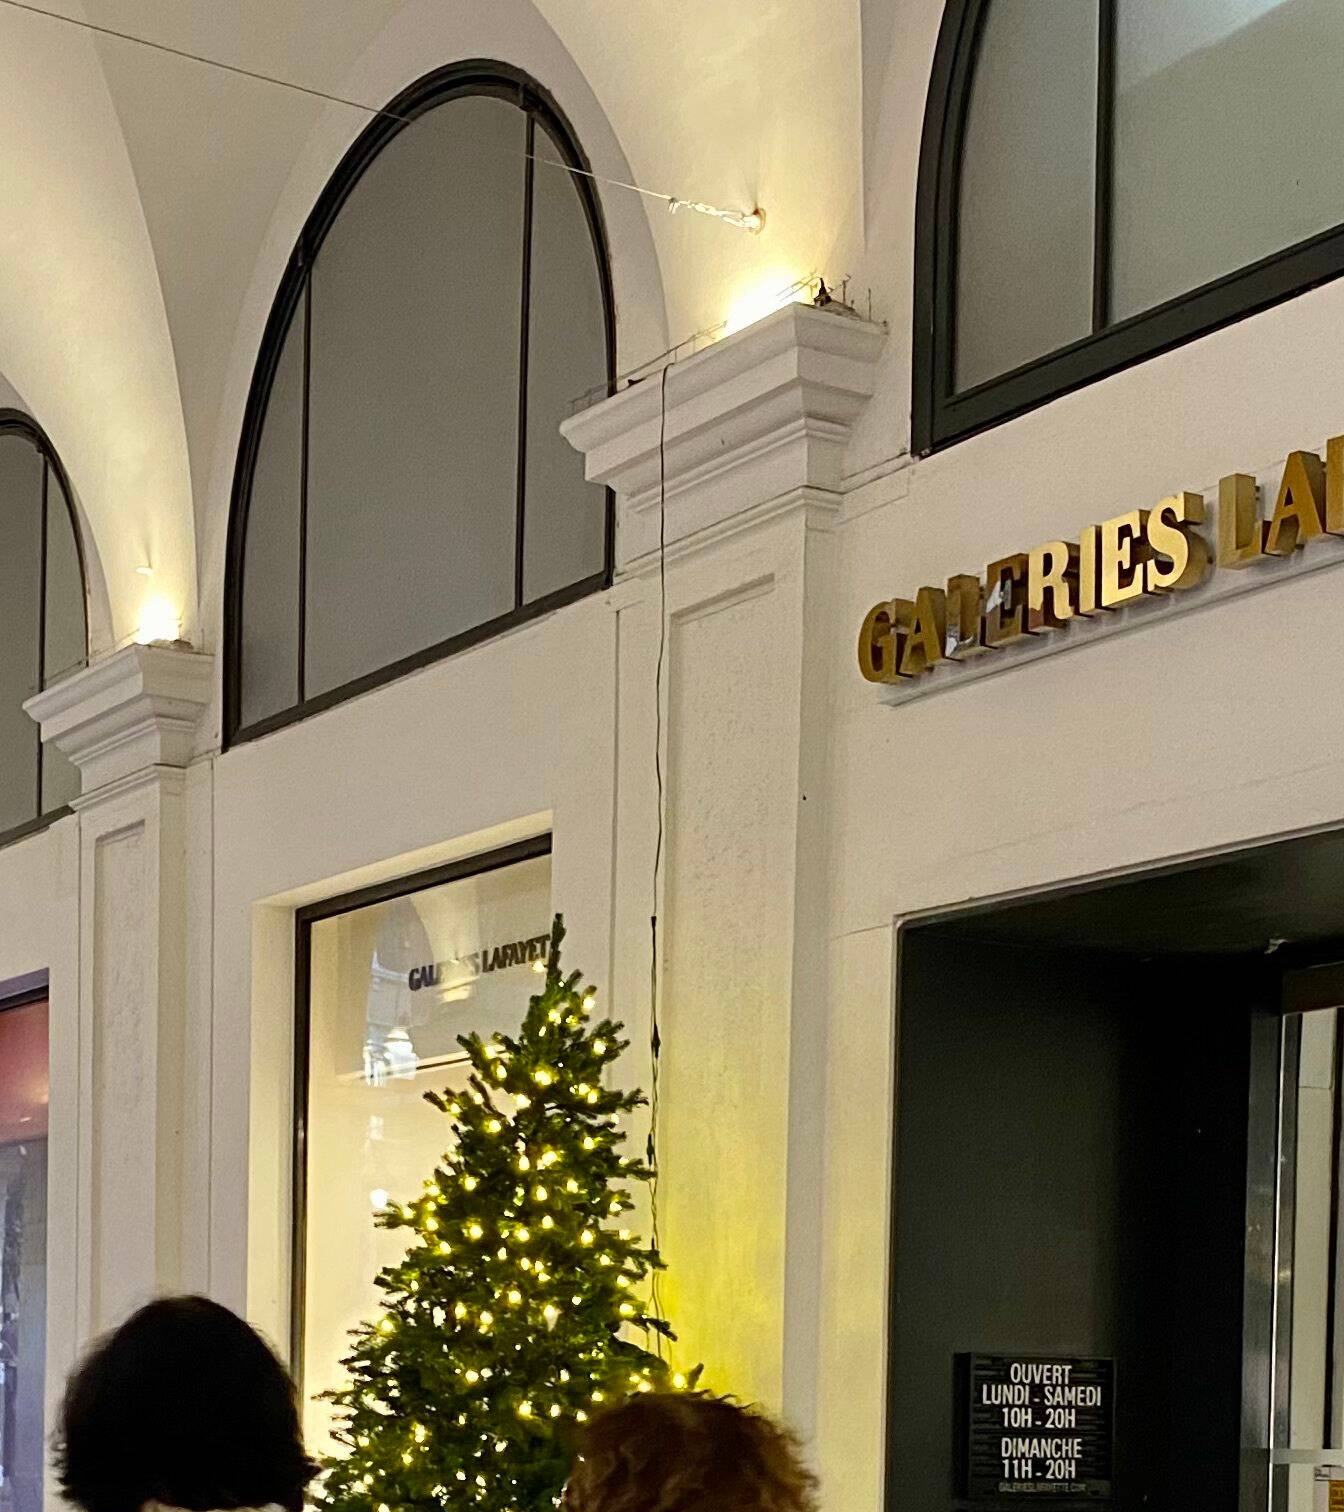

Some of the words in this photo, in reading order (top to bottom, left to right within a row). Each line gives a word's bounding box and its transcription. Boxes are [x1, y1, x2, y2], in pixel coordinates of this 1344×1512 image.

[856, 491, 1208, 686] GALERIES
[482, 933, 551, 973] LAFAYET
[1010, 1363, 1072, 1385] OUVERT
[982, 1384, 1030, 1406] LUNDI
[1044, 1386, 1101, 1406] SAMEDI
[1001, 1407, 1033, 1428] 10H
[1045, 1407, 1076, 1429] 20H
[1001, 1438, 1082, 1459] DIMANCHE
[1001, 1459, 1032, 1480] 11H
[1045, 1459, 1076, 1480] 20H
